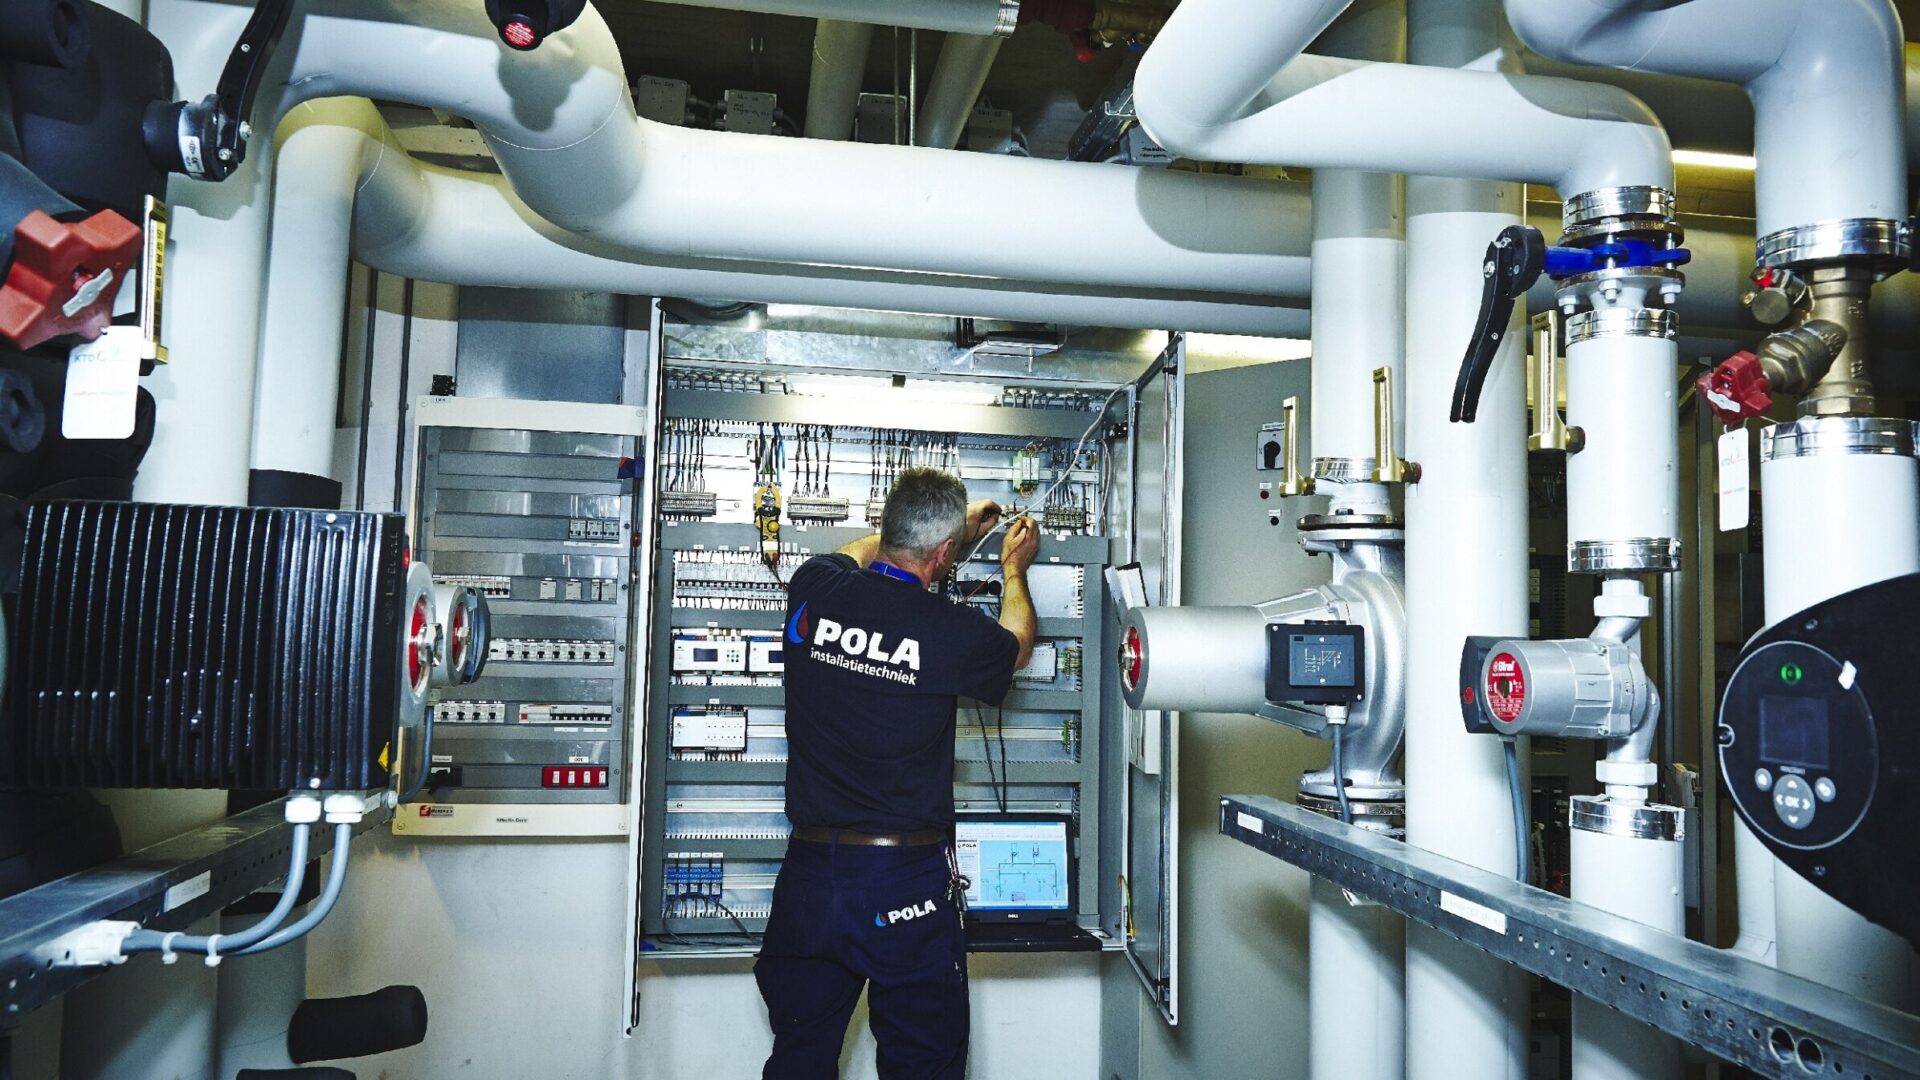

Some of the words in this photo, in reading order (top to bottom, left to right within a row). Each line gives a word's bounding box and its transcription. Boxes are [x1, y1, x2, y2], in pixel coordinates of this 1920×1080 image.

[813, 617, 920, 671] POLA
[810, 647, 917, 686] installatietechniek
[1784, 795, 1800, 808] OK
[887, 899, 937, 924] POLA
